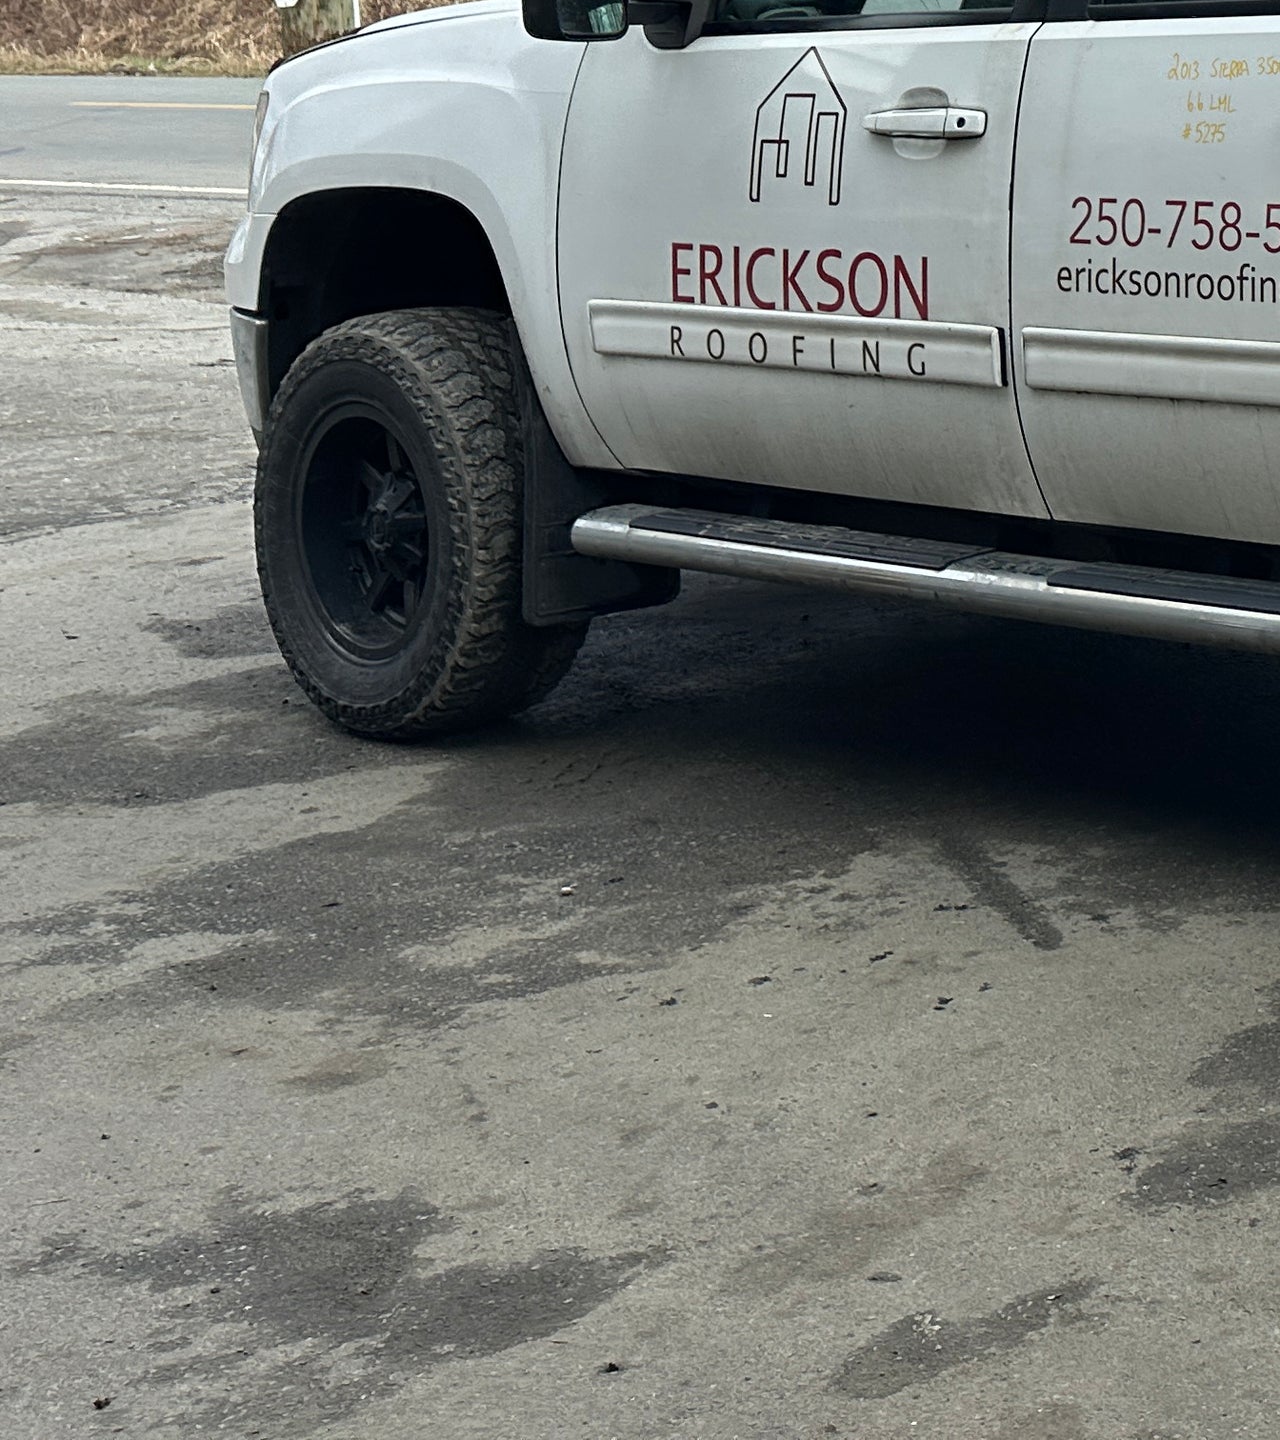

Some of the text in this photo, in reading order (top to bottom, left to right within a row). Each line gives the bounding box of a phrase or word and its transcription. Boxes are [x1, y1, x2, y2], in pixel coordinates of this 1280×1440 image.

[1167, 52, 1200, 81] 2013
[1209, 57, 1250, 80] SIERRA
[670, 242, 929, 321] ERICKSON
[670, 325, 927, 377] ROOFING
